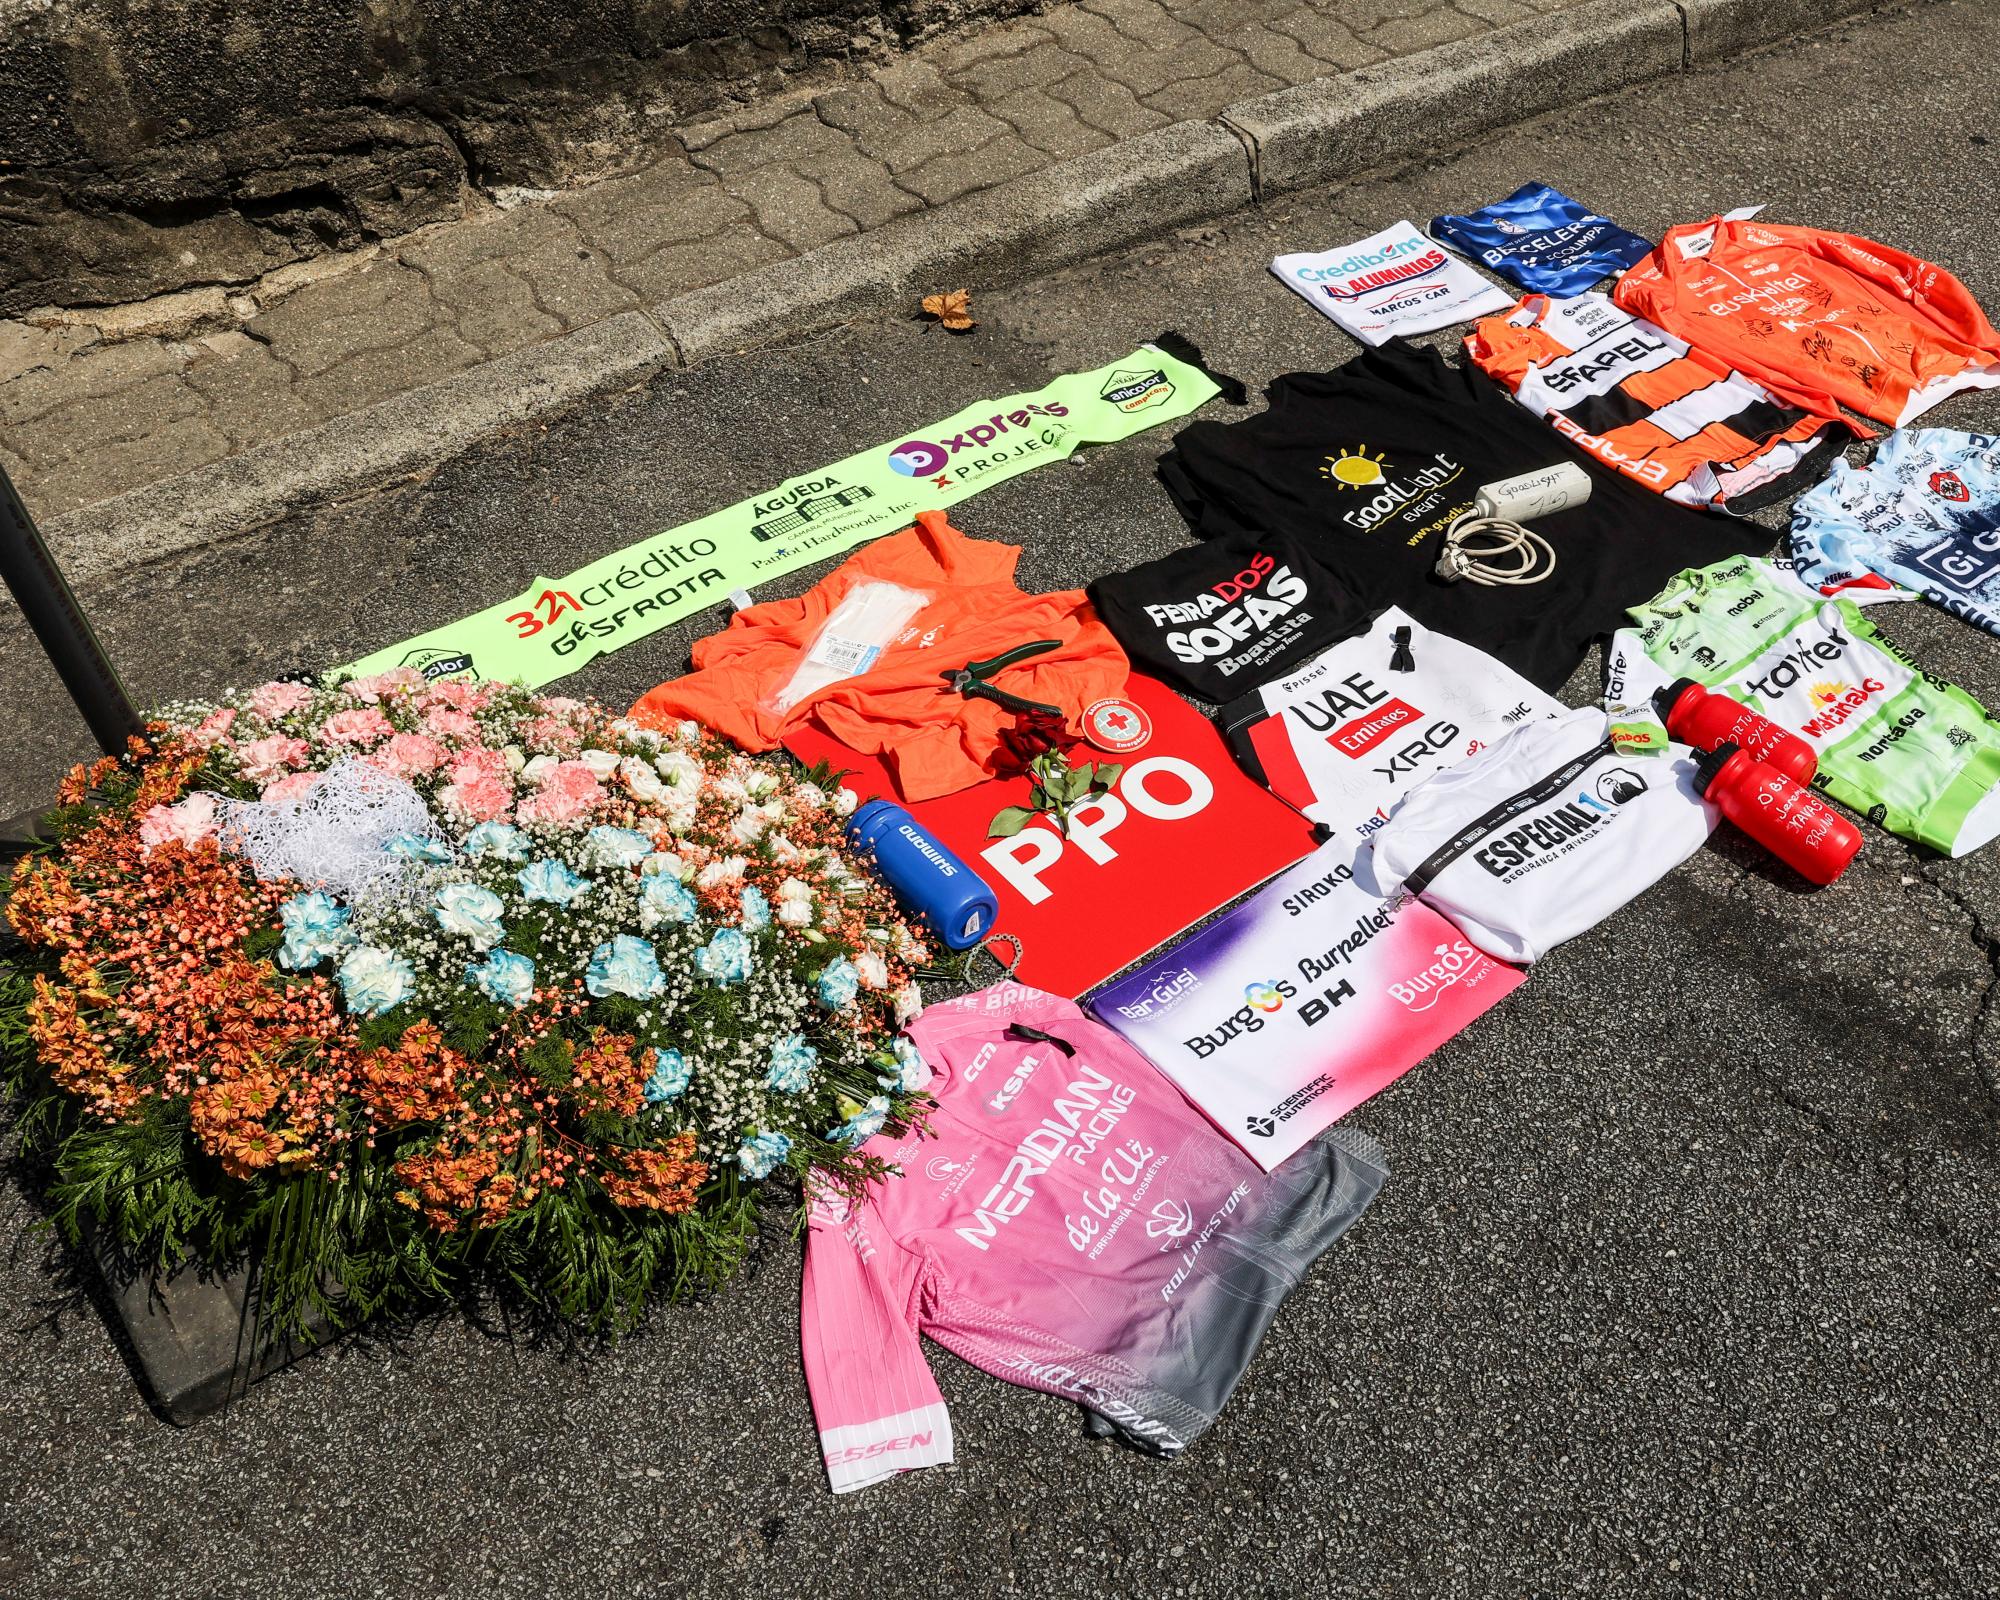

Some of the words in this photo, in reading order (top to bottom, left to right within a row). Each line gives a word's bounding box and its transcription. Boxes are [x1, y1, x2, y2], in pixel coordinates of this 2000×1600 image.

[1297, 236, 1426, 282] Credibom
[1546, 226, 1606, 261] ECOLIMPA
[1369, 297, 1422, 317] MARCOS
[1425, 287, 1451, 302] CAR
[1587, 319, 1620, 337] EFAPEL
[1110, 376, 1160, 401] anicolor
[1543, 337, 1666, 393] EFAPEL
[753, 476, 842, 519] ÁGUEDA
[888, 501, 918, 516] Inc.
[1403, 492, 1446, 522] EVENTS
[1166, 565, 1308, 663] SOFÁS
[1254, 643, 1286, 667] Cycling
[1285, 631, 1304, 646] Team
[1292, 665, 1328, 689] PISSEI
[1603, 651, 1627, 702] tavfer
[1288, 672, 1389, 731] UAE
[1510, 701, 1532, 721] IHC
[1339, 707, 1409, 751] Emirates
[1371, 721, 1460, 784] XRG
[1857, 708, 1926, 762] mortágua
[899, 825, 958, 877] SHIMANO
[979, 756, 1214, 906] PPO
[1282, 863, 1354, 916] SIROKO
[1297, 907, 1395, 984] Burpellet
[1117, 999, 1153, 1020] Bar
[1152, 967, 1199, 1005] Gusi
[1387, 941, 1474, 1005] Burgos
[1297, 978, 1357, 1027] BH
[989, 1055, 1039, 1111] KSM
[1065, 1083, 1137, 1165] RACING
[938, 1153, 978, 1202] JETSTREAM
[955, 1065, 1113, 1250] MERIDIAN
[1082, 1186, 1122, 1220] la
[1065, 1213, 1100, 1252] de
